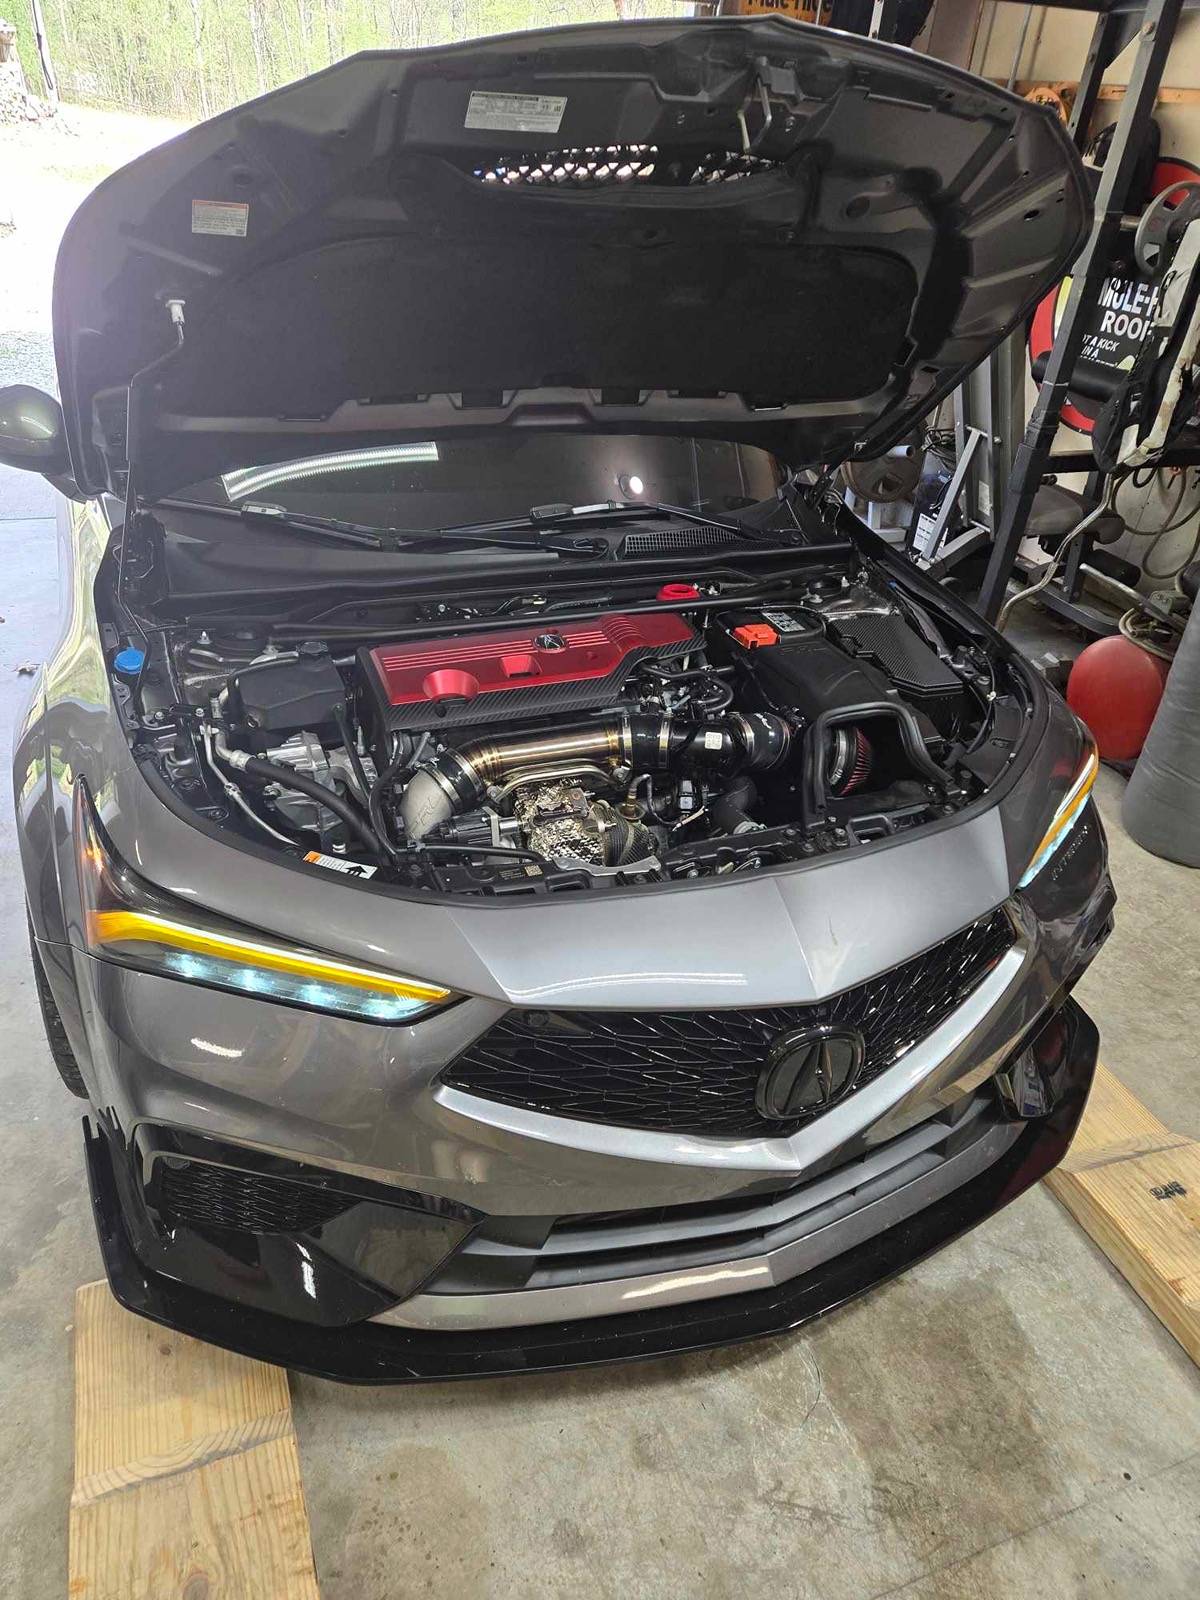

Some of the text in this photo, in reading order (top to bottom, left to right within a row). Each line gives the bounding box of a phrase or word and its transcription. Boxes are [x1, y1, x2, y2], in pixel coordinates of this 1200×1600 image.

[1089, 336, 1098, 347] A
[1096, 338, 1120, 352] KICK
[1081, 346, 1100, 358] IN A
